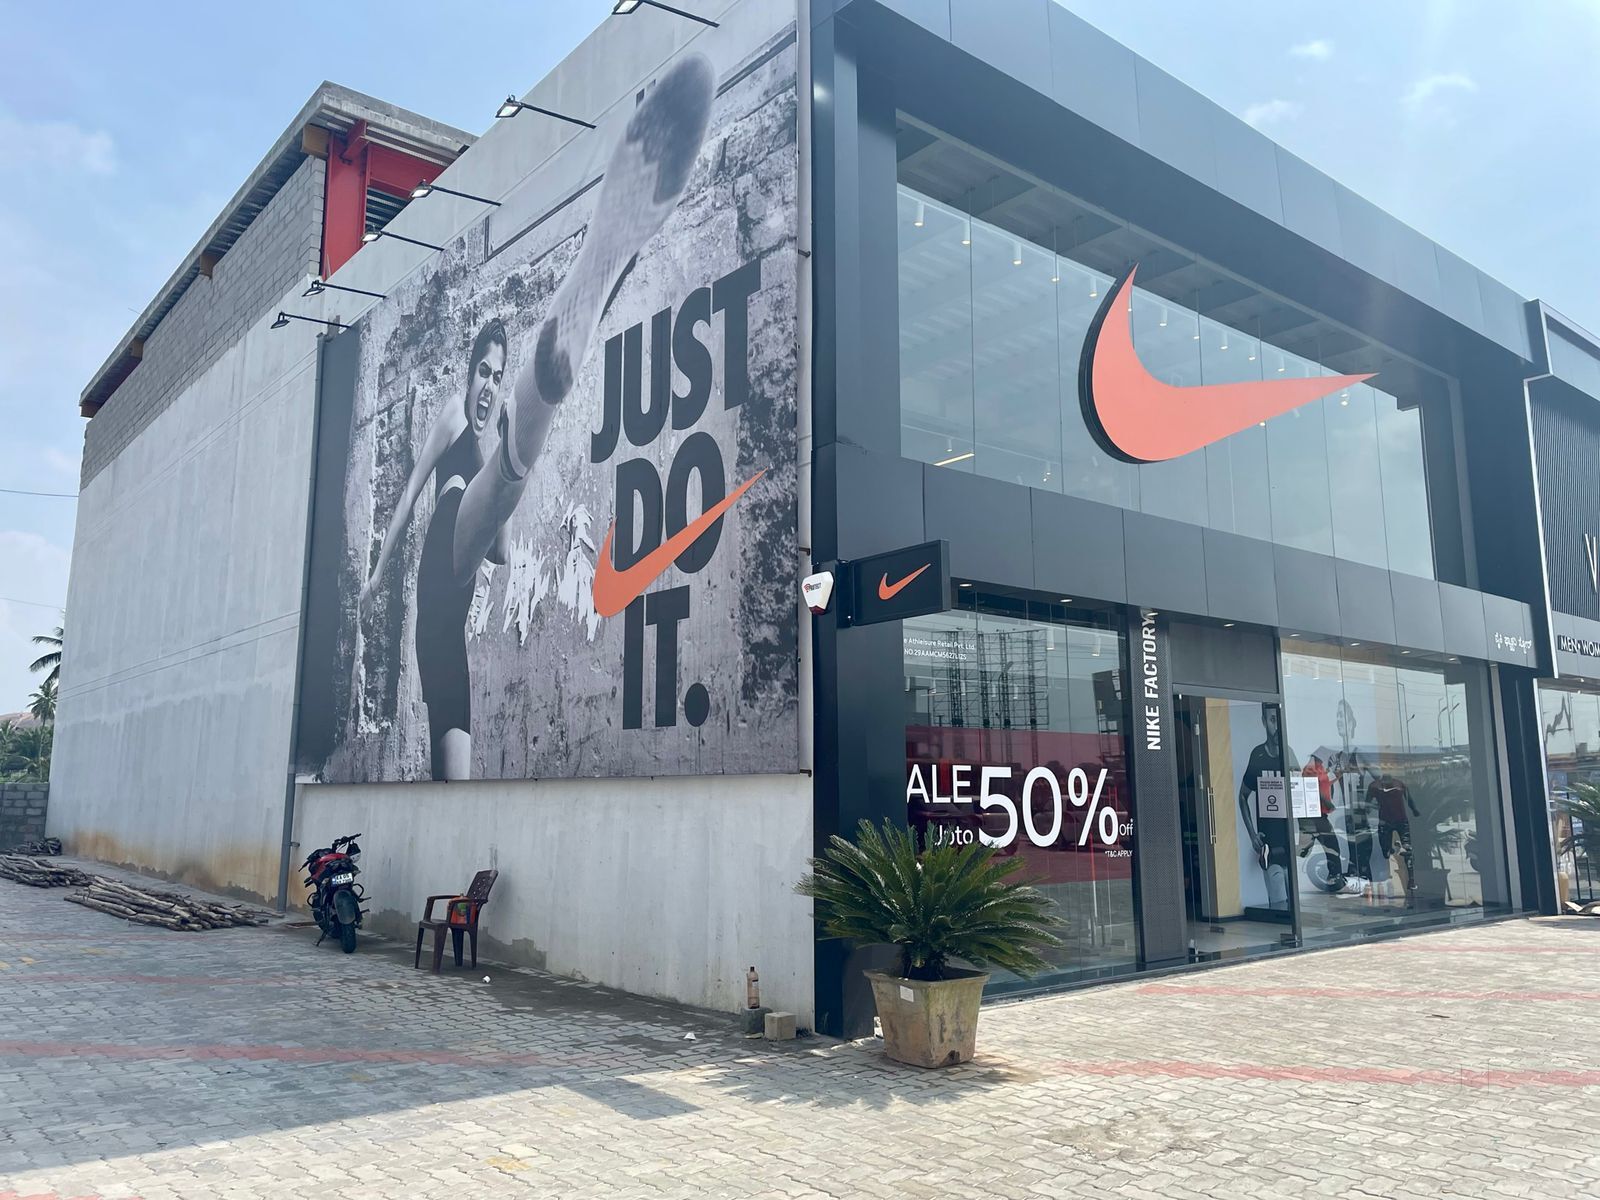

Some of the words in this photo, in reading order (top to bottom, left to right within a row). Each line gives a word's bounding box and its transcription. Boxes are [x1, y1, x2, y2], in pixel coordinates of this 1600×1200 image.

[591, 260, 762, 464] JUST
[614, 431, 726, 574] DO
[622, 584, 711, 730] IT.
[1141, 612, 1158, 699] FACTORY
[1559, 635, 1578, 653] MEN
[1145, 705, 1162, 751] NIKE
[979, 766, 1119, 848] 50%
[1119, 823, 1133, 836] Off
